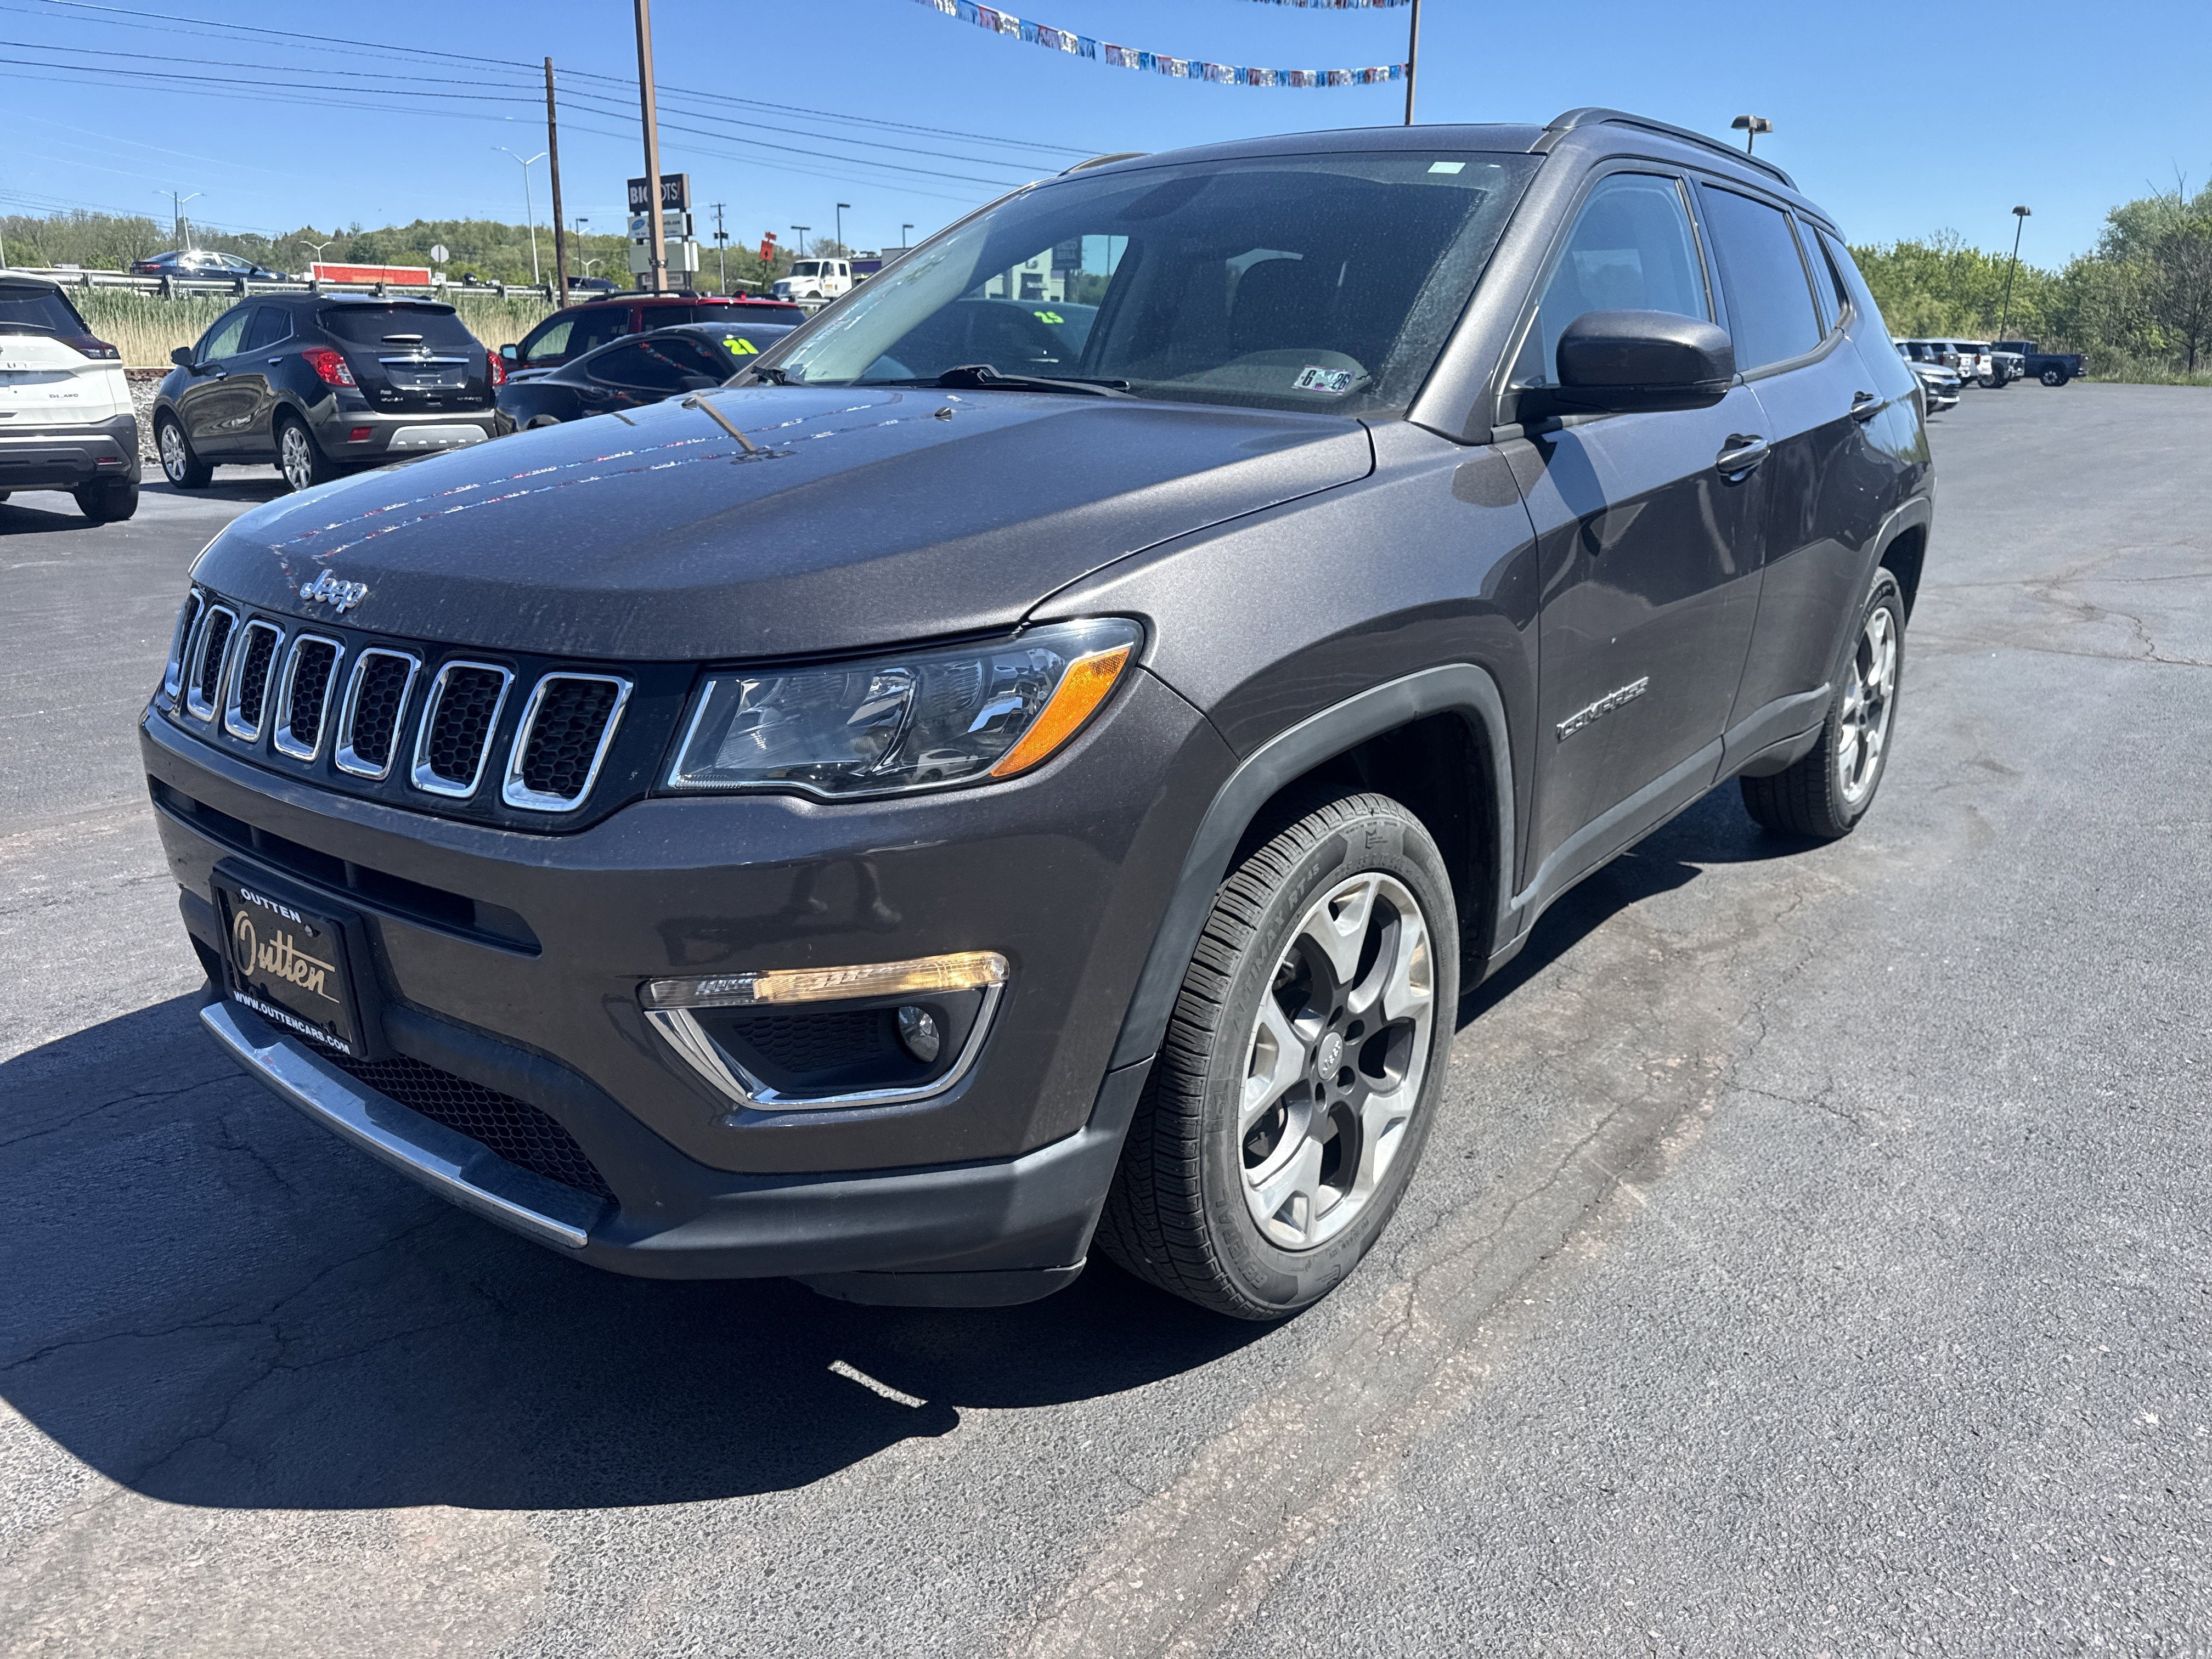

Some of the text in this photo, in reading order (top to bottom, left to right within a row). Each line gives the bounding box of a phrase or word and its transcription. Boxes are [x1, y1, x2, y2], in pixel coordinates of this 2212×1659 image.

[1034, 311, 1064, 323] 25
[723, 338, 759, 355] 21
[1331, 373, 1351, 390] 26
[300, 569, 368, 614] Jeep
[240, 887, 302, 924] OUTTEN
[233, 910, 340, 1003] Outten
[233, 990, 351, 1056] WWW.OUTTENCARS.COM
